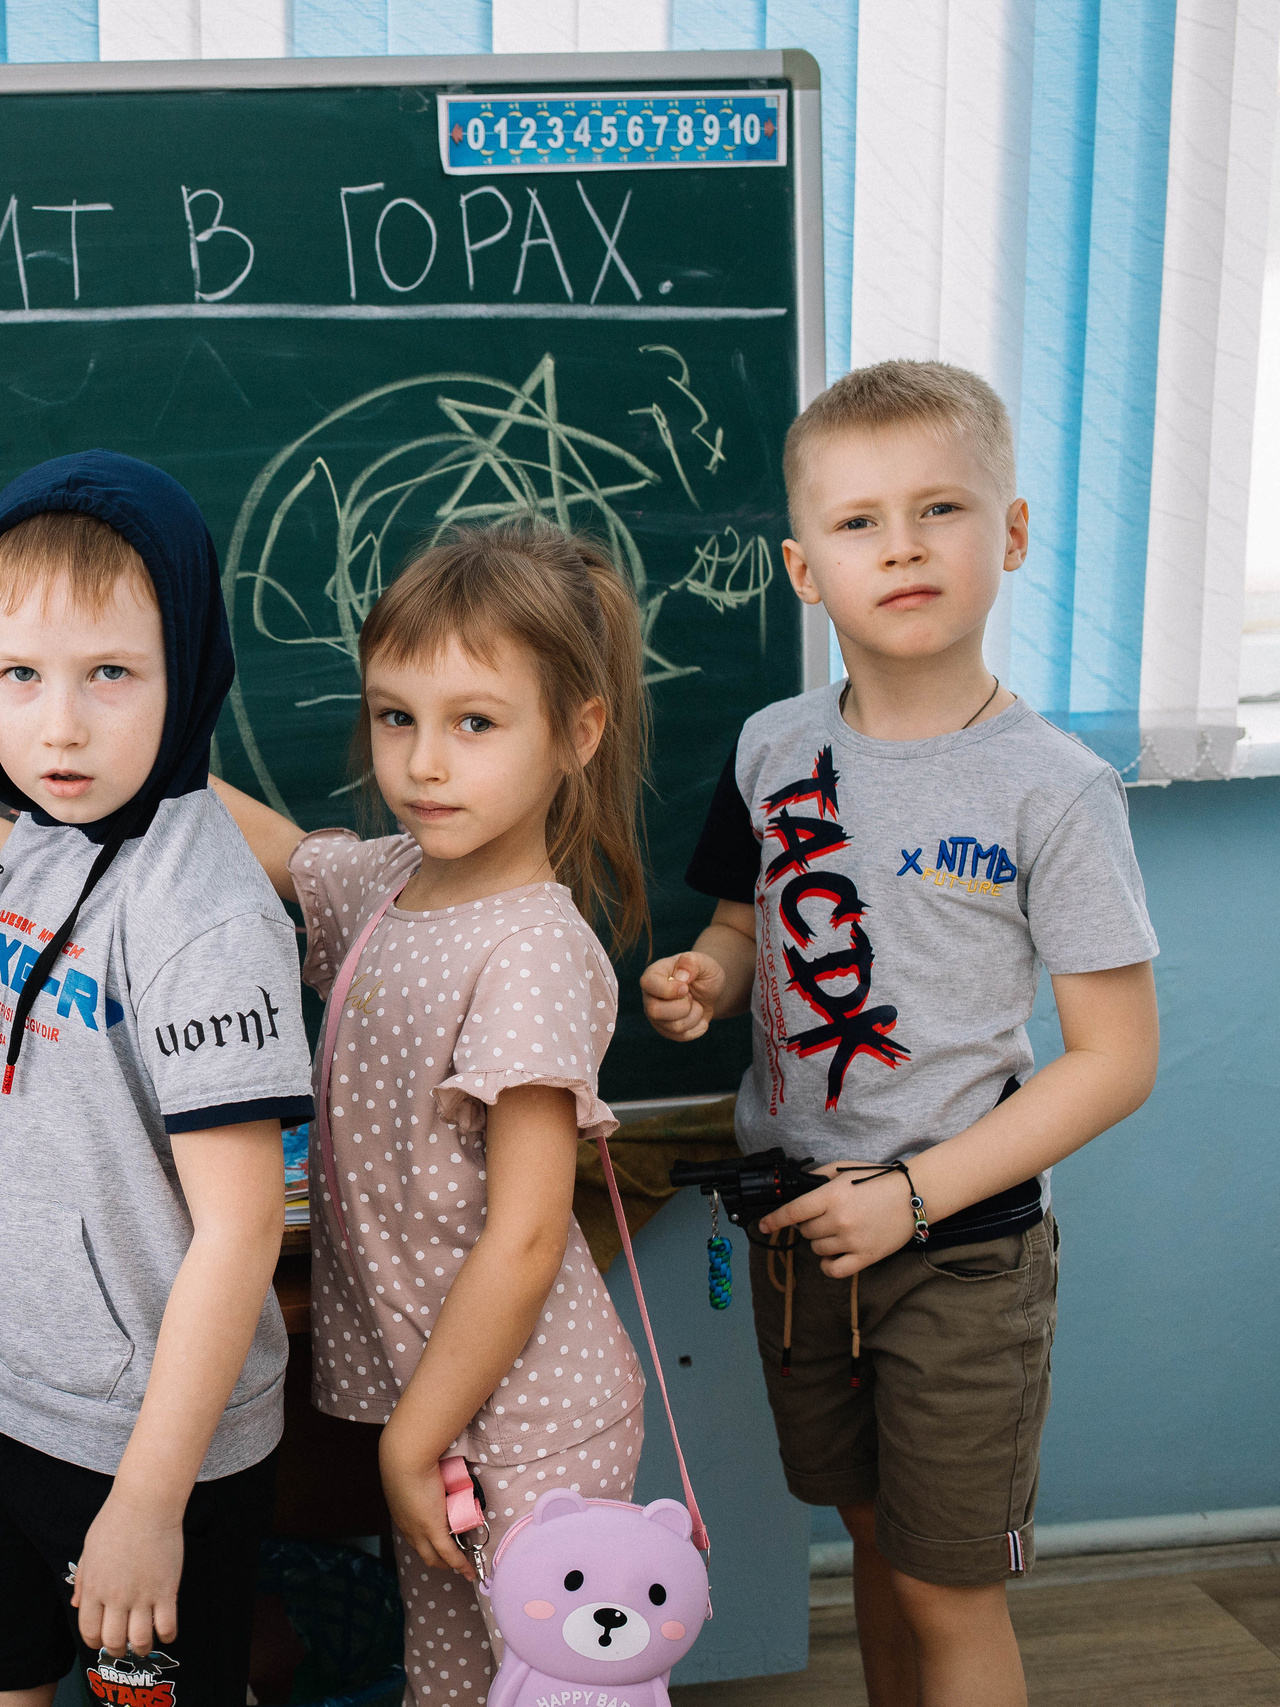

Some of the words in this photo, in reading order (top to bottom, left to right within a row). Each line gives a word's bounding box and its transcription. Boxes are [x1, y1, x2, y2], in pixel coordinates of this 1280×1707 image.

[467, 117, 486, 150] 0
[493, 117, 509, 149] 1
[519, 117, 538, 149] 2
[546, 116, 564, 148] 3
[572, 115, 591, 147] 4
[599, 115, 618, 147] 5
[626, 115, 645, 147] 6
[651, 114, 669, 146] 7
[676, 114, 695, 146] 8
[702, 113, 721, 146] 9
[728, 112, 761, 145] 10
[181, 184, 256, 302] В
[340, 179, 674, 304] ГОРАХ.
[921, 867, 1005, 897] FUT-URE
[87, 1669, 174, 1707] STARS
[100, 1666, 154, 1687] BRAWL
[536, 1690, 594, 1707] HAPPY
